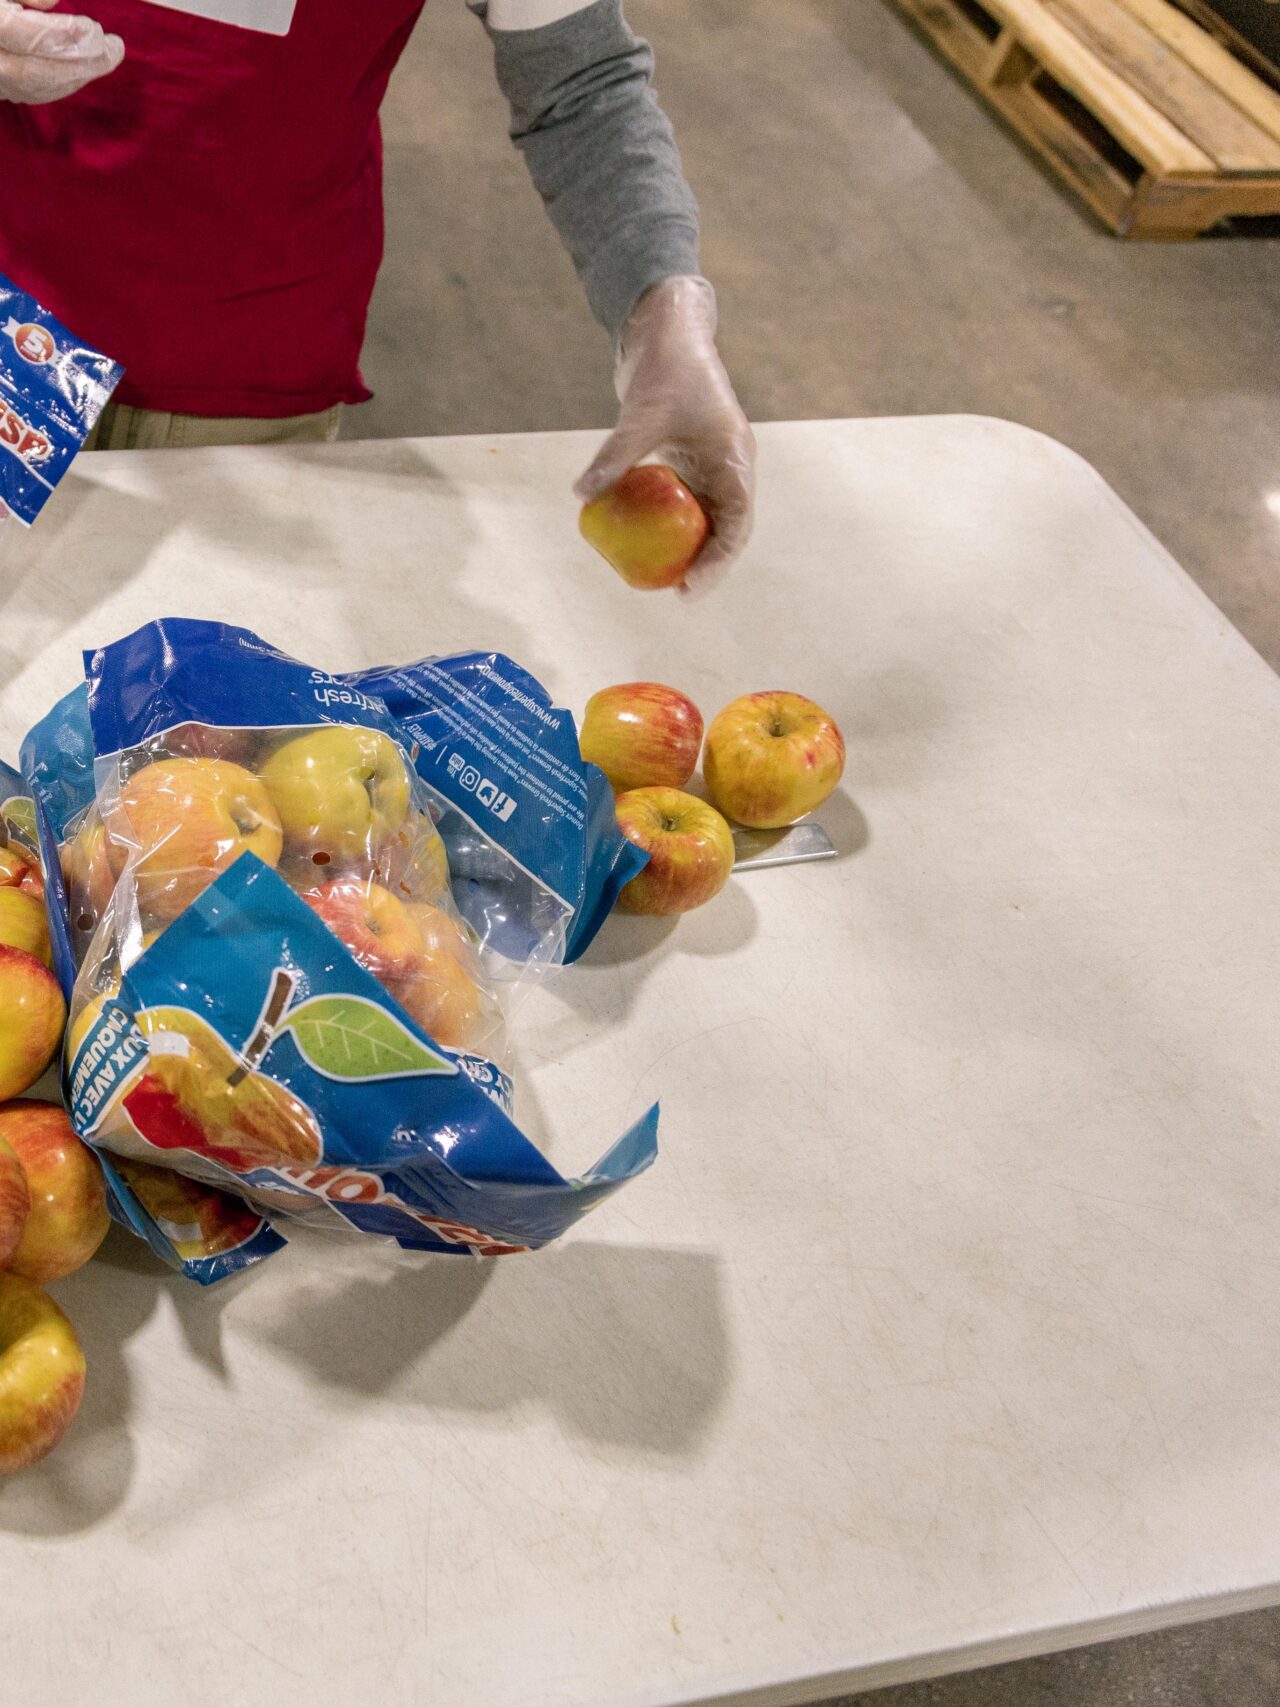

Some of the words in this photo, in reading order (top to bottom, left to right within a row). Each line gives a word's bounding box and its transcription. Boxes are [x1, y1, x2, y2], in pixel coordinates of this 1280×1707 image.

[23, 327, 47, 356] 5
[525, 771, 547, 790] continue
[550, 767, 578, 792] Superfresh
[538, 793, 565, 816] Superfresh
[80, 1061, 116, 1118] AVEC
